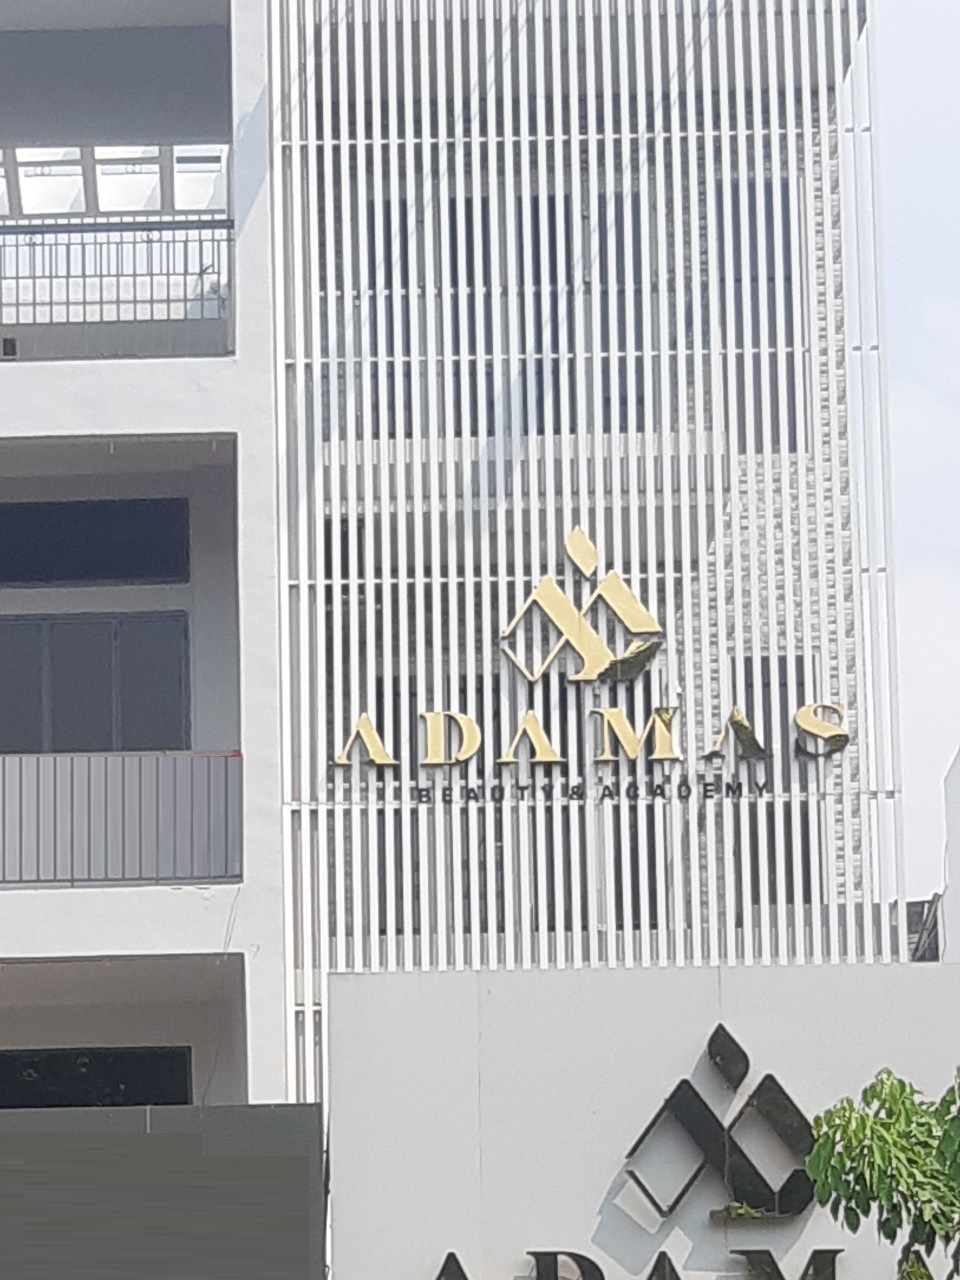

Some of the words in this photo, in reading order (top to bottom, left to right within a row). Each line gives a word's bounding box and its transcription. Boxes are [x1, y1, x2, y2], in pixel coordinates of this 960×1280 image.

[328, 703, 851, 766] ADAMAS
[417, 784, 556, 804] BEAUTY
[598, 780, 773, 801] ACADEMY
